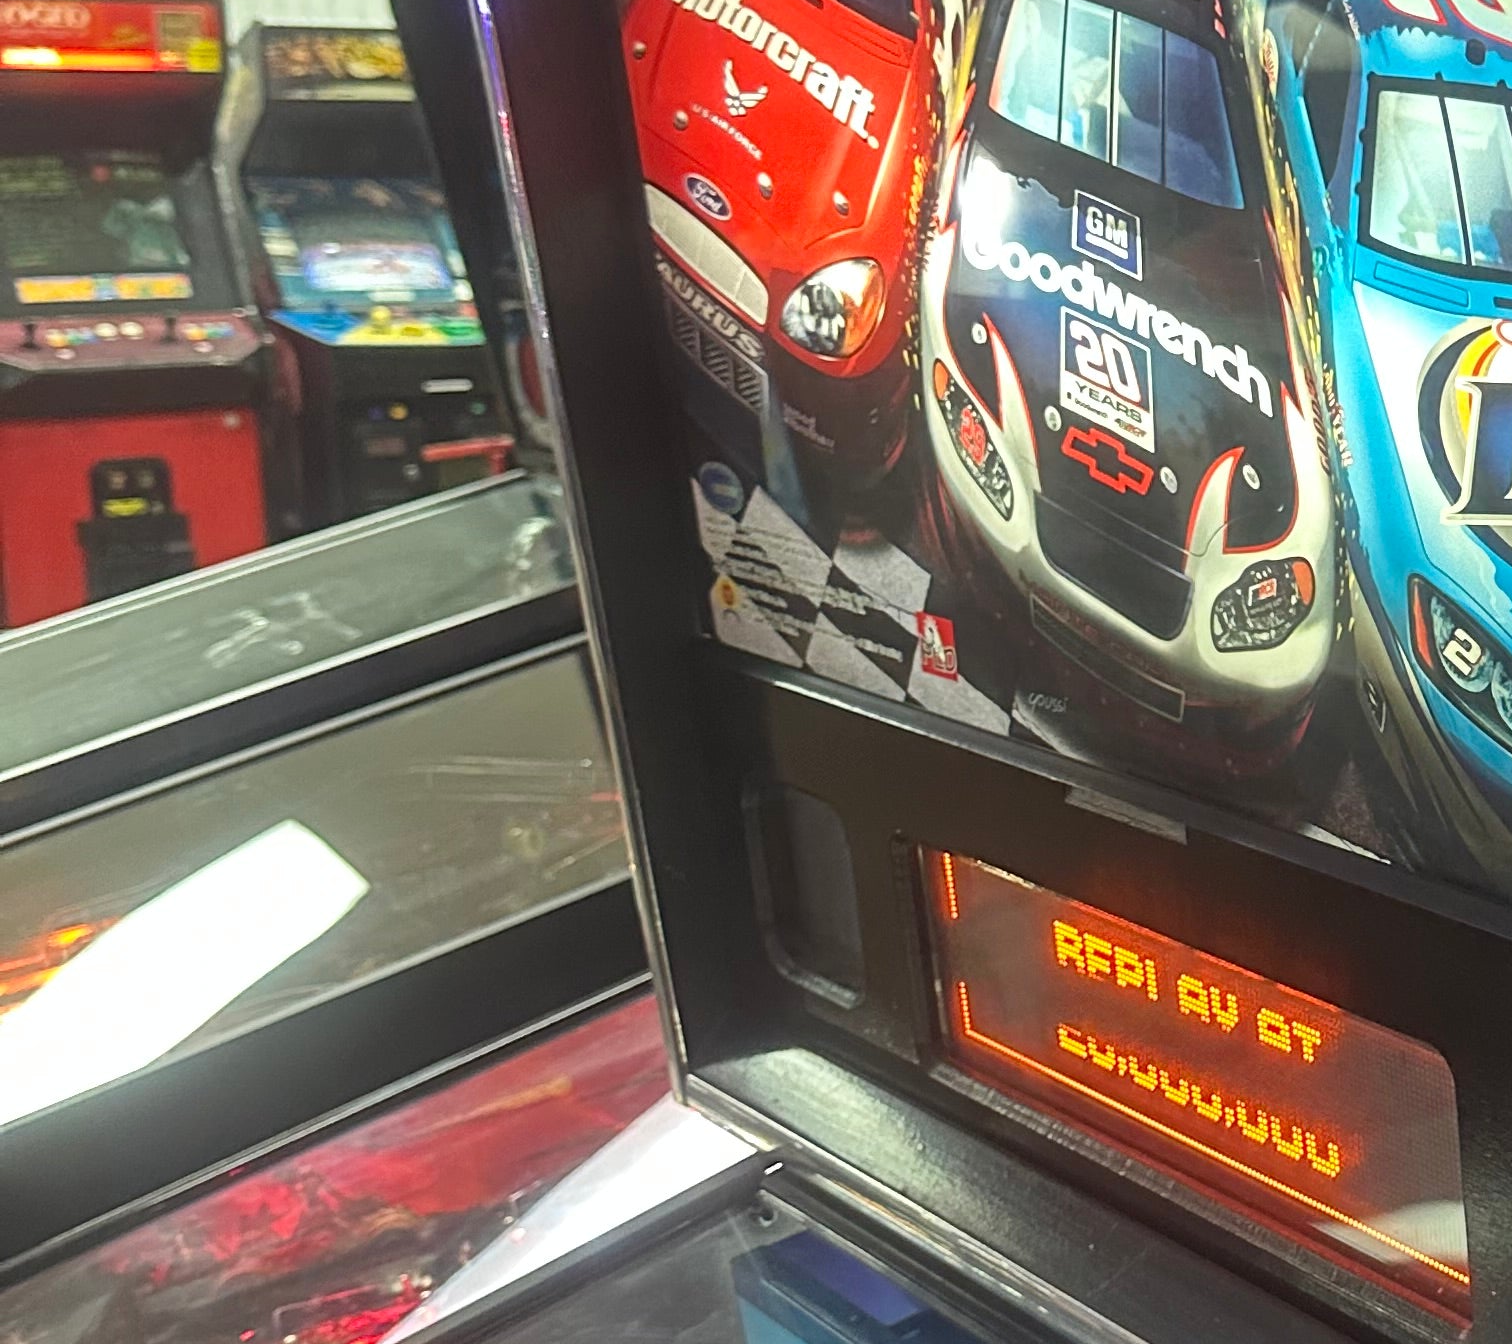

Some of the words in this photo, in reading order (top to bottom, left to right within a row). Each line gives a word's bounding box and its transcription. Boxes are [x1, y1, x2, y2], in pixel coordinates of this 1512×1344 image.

[1085, 204, 1129, 250] GM
[656, 253, 765, 363] AURUS
[1069, 319, 1143, 404] 20
[1075, 380, 1143, 424] YEARS
